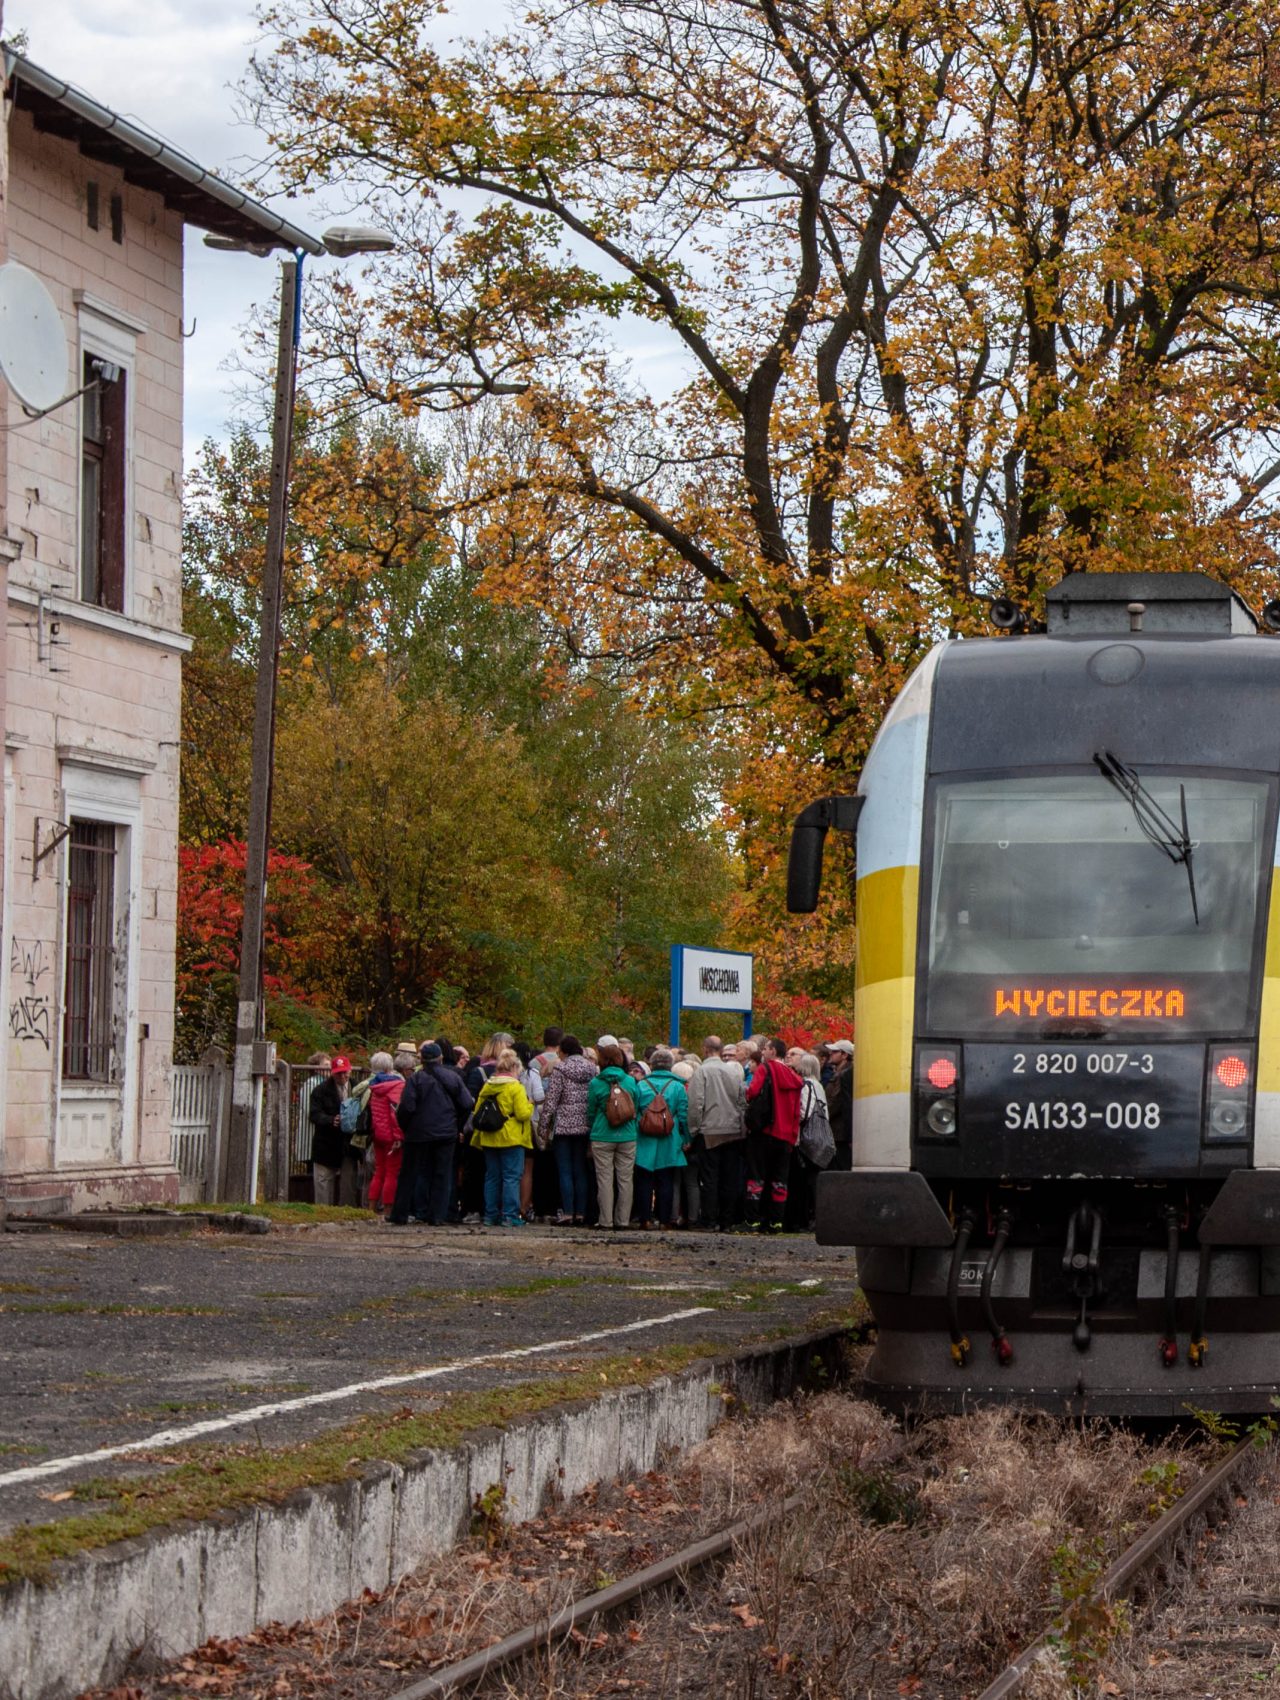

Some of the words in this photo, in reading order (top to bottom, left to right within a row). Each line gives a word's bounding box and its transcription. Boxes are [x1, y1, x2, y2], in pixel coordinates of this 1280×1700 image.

[698, 966, 740, 995] WSCHOWA
[995, 989, 1185, 1017] WYCIECZKA
[1012, 1053, 1026, 1074] 2
[1035, 1053, 1077, 1074] 820
[1086, 1053, 1154, 1074] 007-3
[1004, 1101, 1161, 1130] SA133-008
